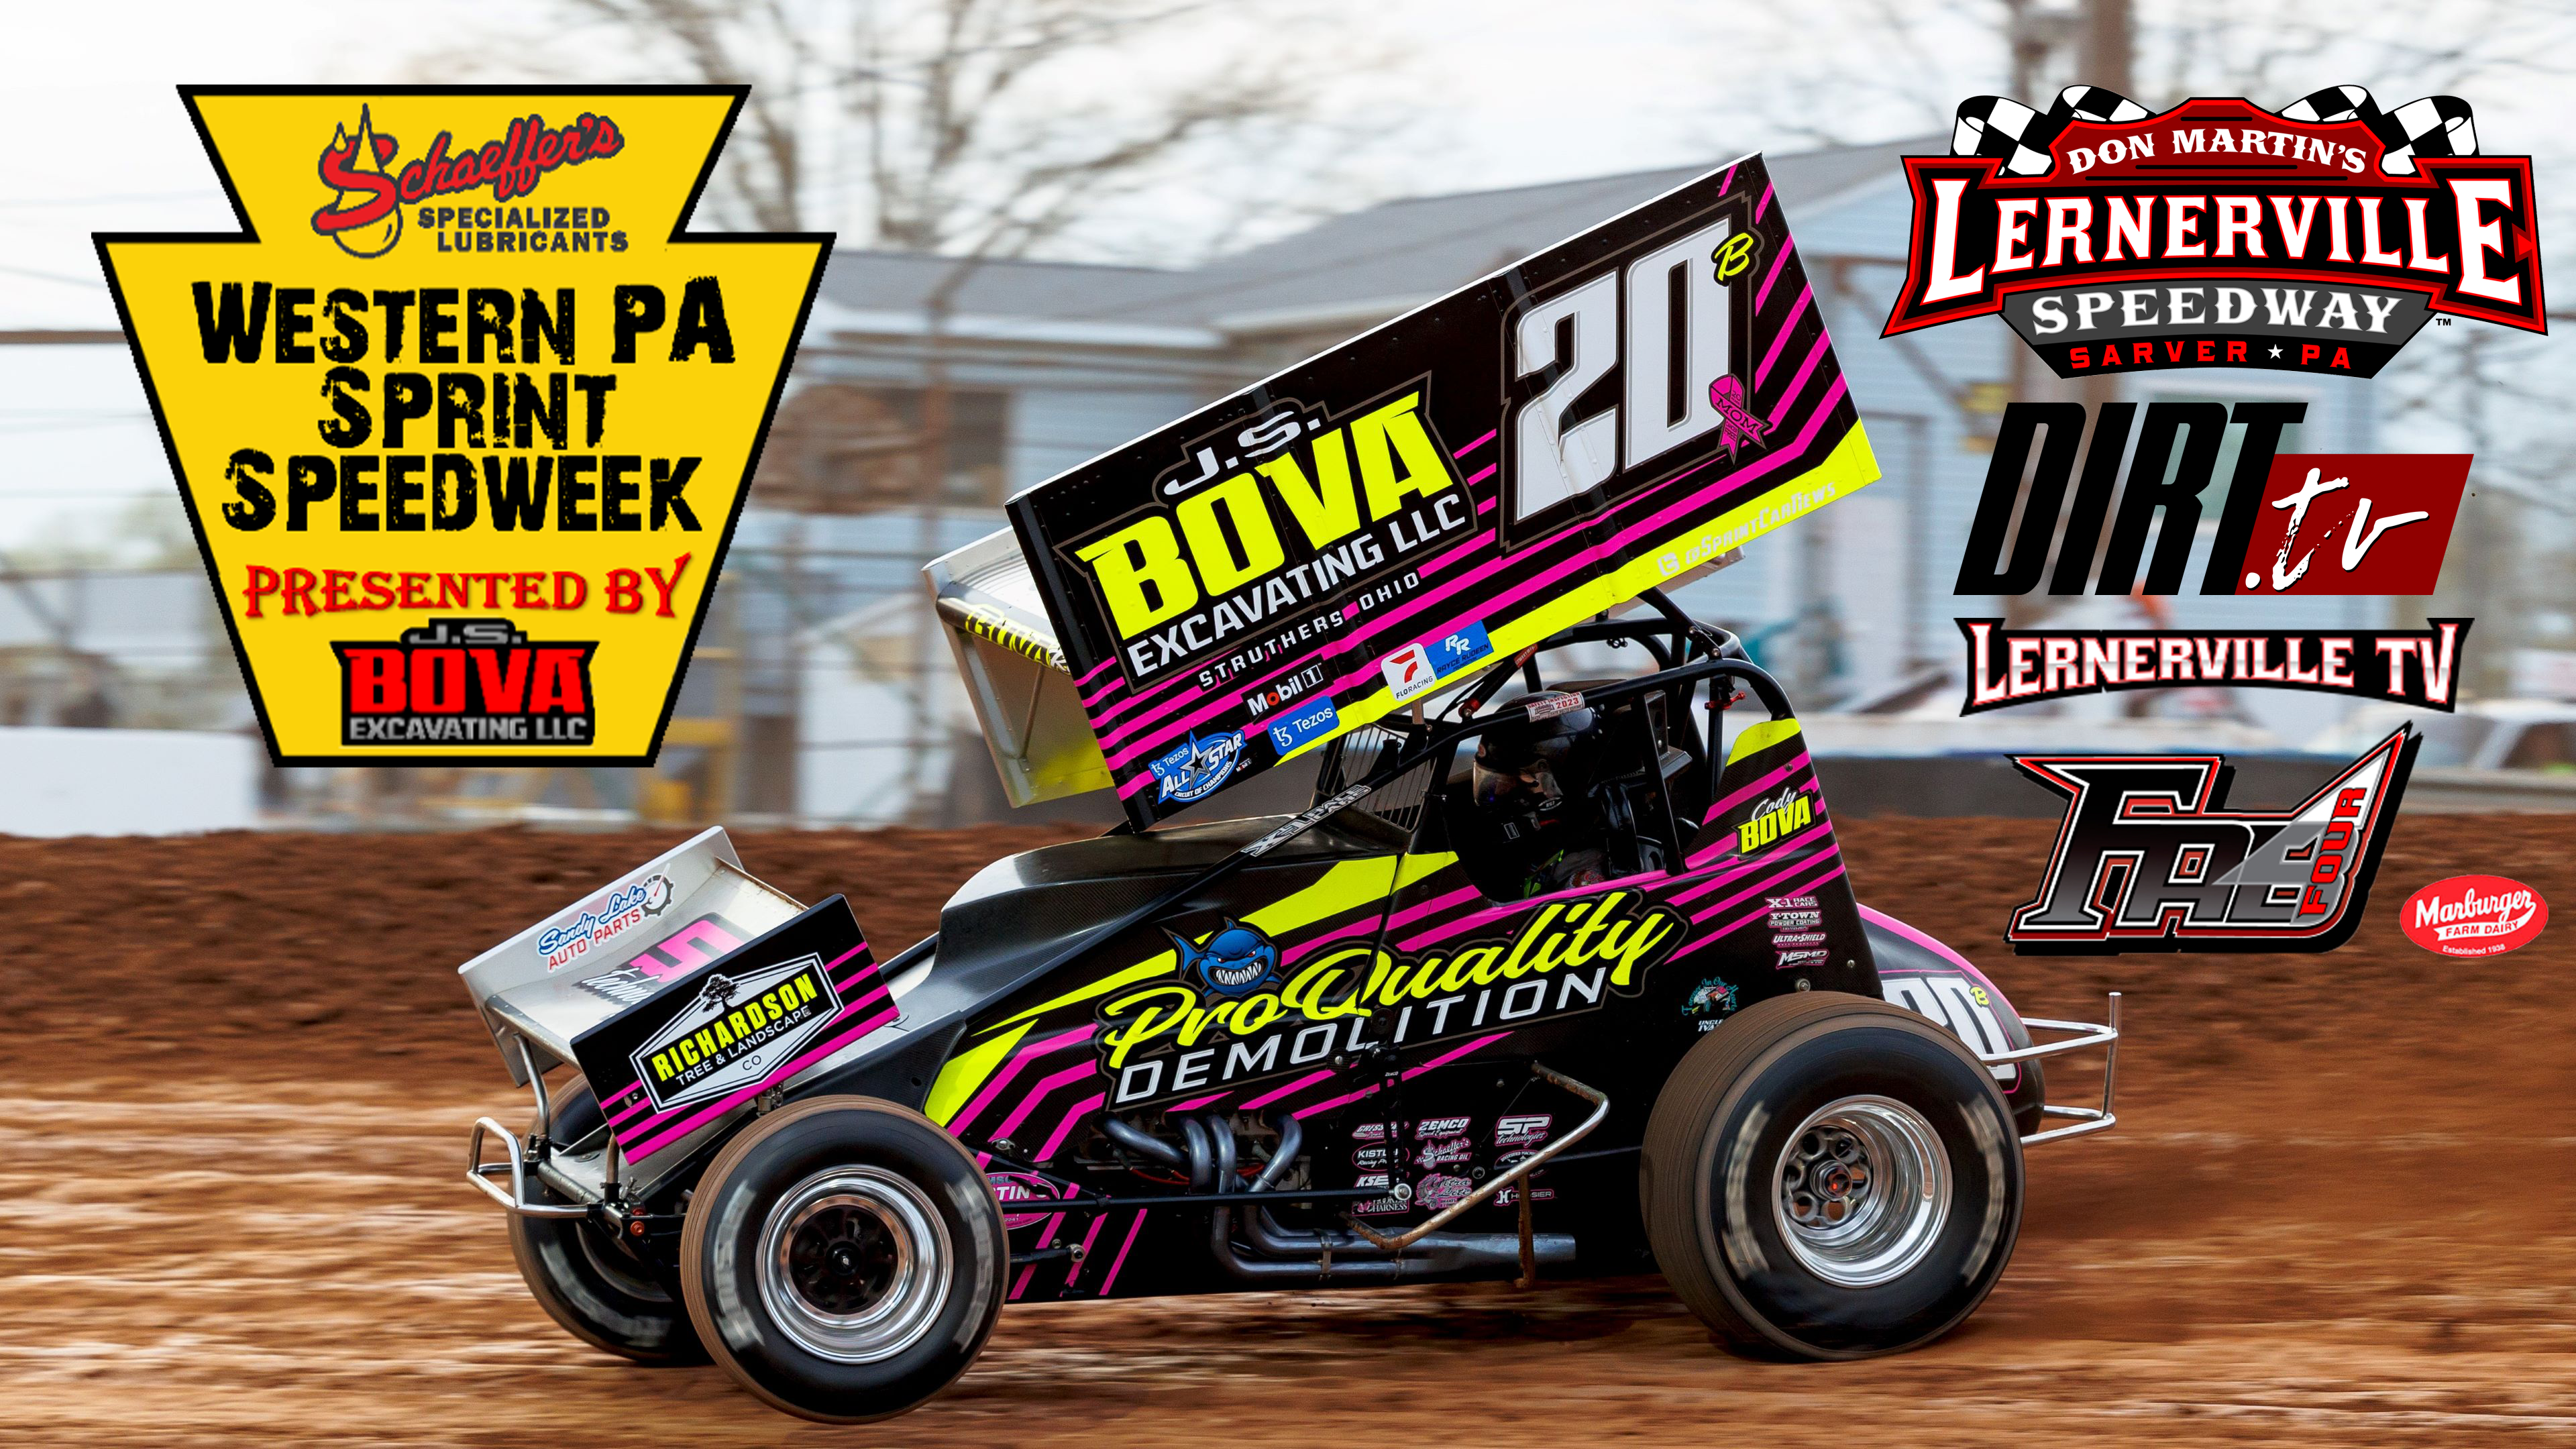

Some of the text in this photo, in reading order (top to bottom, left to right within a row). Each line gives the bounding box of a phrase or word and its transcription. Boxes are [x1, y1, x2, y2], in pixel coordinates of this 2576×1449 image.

[1517, 218, 1754, 521] 20 B
[1716, 398, 1758, 435] MOM
[1164, 411, 1321, 495] J.S.
[1075, 391, 1453, 641] BOVA
[1128, 493, 1466, 678] EXCAVATING LLC
[1199, 572, 1419, 687] STRUTHERS OHIO
[1436, 657, 1460, 674] RAYCE
[1462, 643, 1489, 661] RUDEEN
[1247, 676, 1303, 716] Mobil
[1396, 676, 1434, 698] FLORACING
[1556, 698, 1579, 709] 2023
[1292, 708, 1333, 733] Tezos
[1162, 733, 1242, 798] ALL STAR
[1163, 747, 1189, 767] Tezos
[1194, 787, 1203, 795] OF
[1203, 761, 1232, 791] CHAMPIONS
[1751, 787, 1796, 822] Cody
[1739, 796, 1811, 853] BOVA
[539, 885, 647, 955] Sandy Lake
[1766, 898, 1793, 908] X-1
[549, 909, 641, 970] AUTO PARTS
[1778, 951, 1827, 966] MSMD
[651, 973, 818, 1081] RICHARDSON
[1116, 967, 1607, 1105] DEMOLITION
[676, 1005, 812, 1085] TREE & LANDSCAPE
[742, 1055, 762, 1071] CO
[1417, 1130, 1435, 1138] Speed
[1418, 1118, 1469, 1130] ZEMCO
[1496, 1130, 1546, 1146] technologies
[1497, 1117, 1550, 1135] SP
[1423, 1139, 1469, 1162] Schaeffer's
[1356, 1175, 1389, 1187] KSE
[1373, 1203, 1407, 1212] HARNESS
